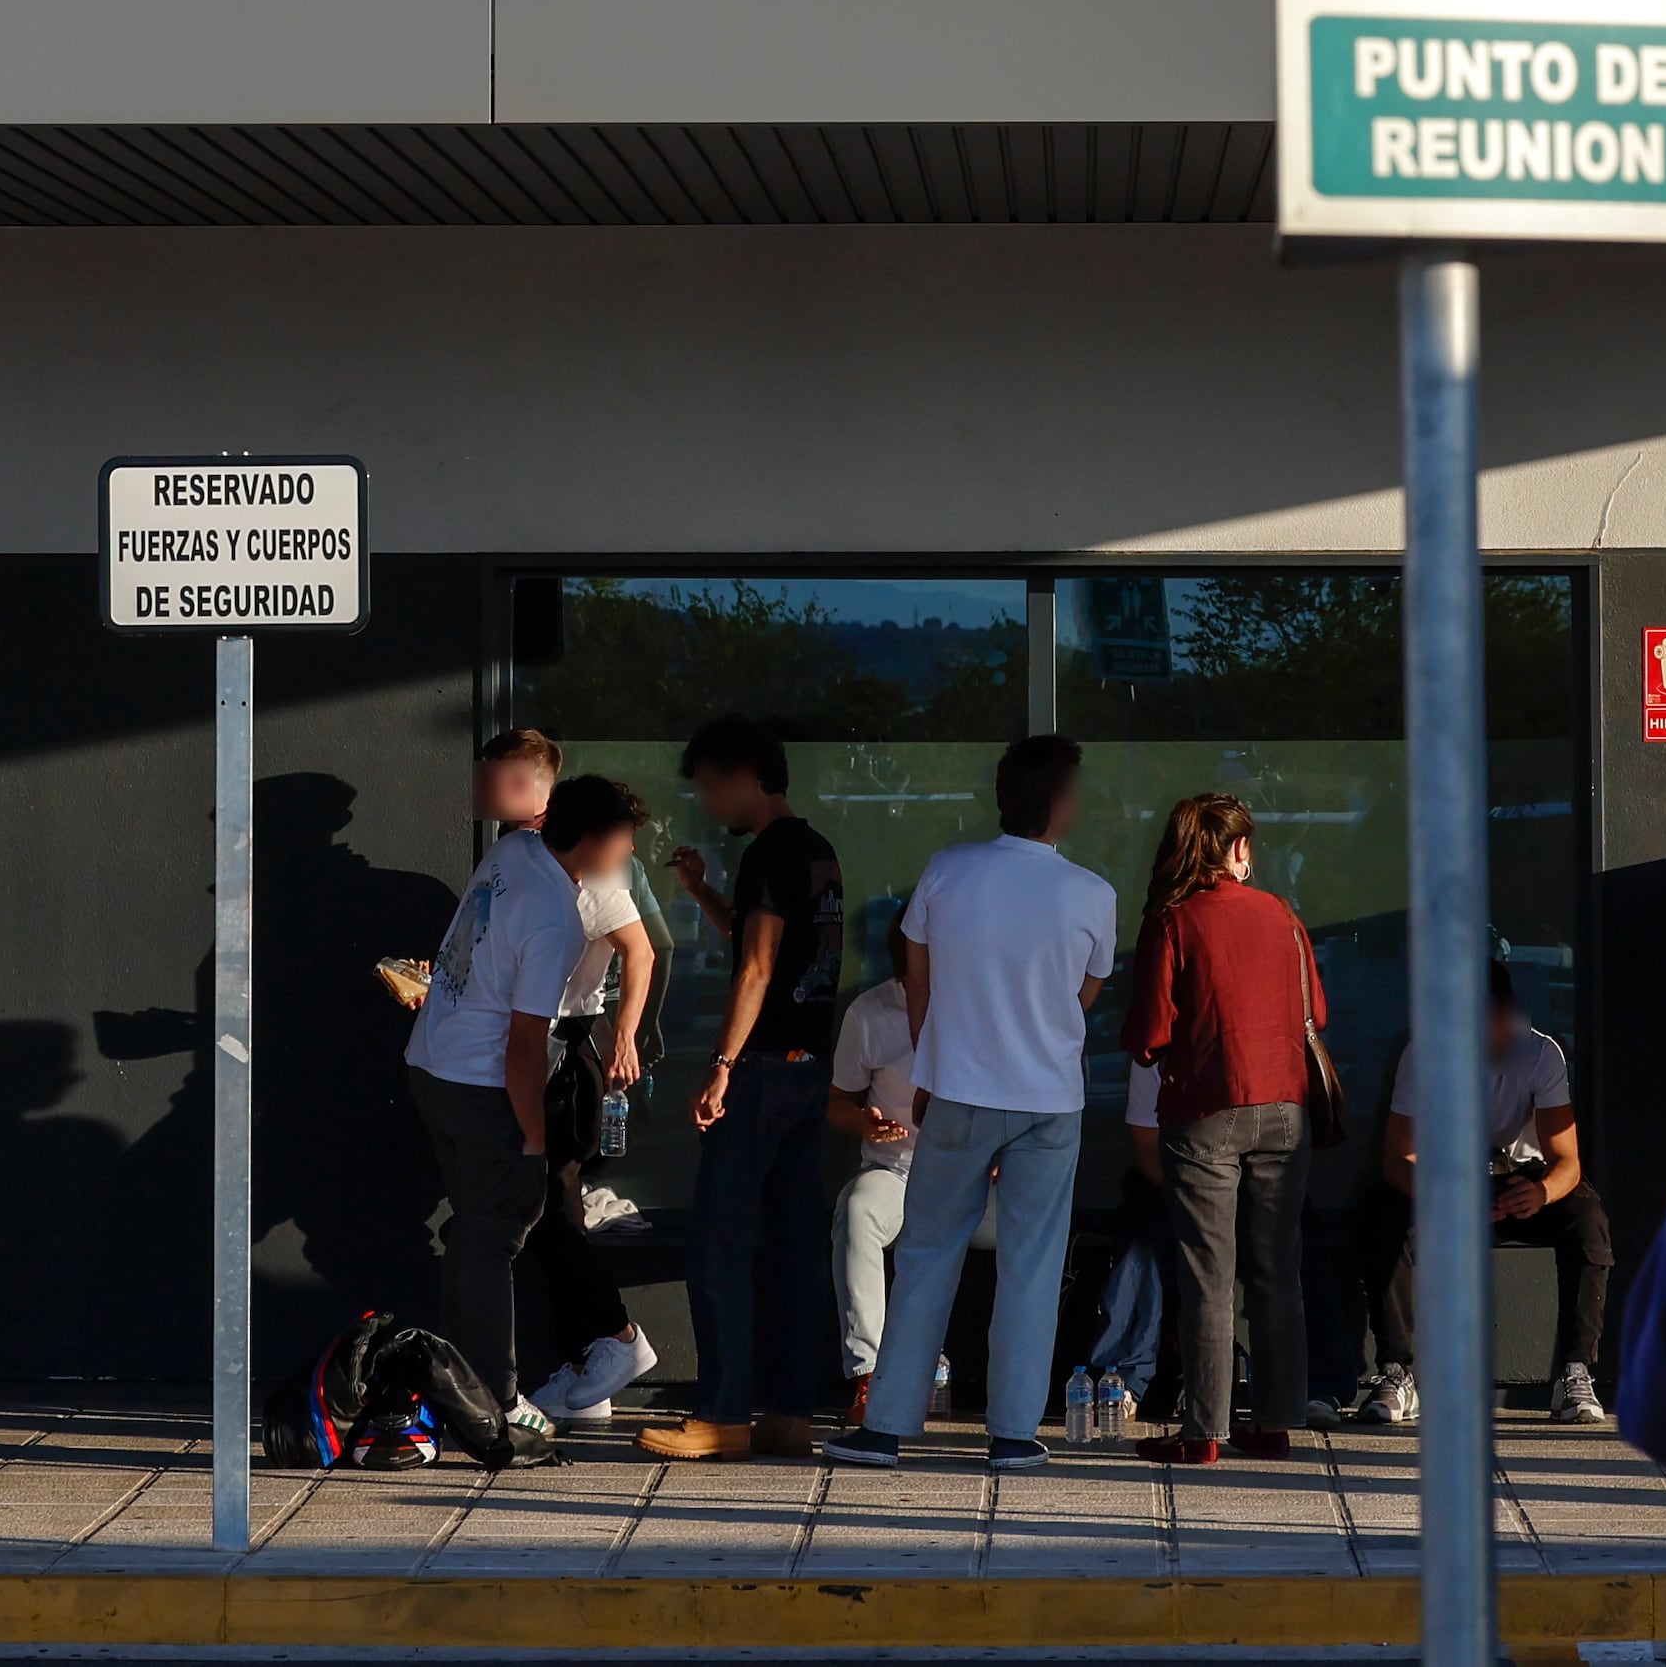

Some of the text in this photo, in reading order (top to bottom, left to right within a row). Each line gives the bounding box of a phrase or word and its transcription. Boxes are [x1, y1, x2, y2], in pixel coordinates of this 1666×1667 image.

[1354, 36, 1579, 104] PUNTO
[1371, 116, 1665, 184] REUNION
[153, 473, 315, 506] RESERVADO
[118, 528, 351, 562] FUERZAS Y CUERPOS
[136, 584, 335, 618] DE SEGURIDAD
